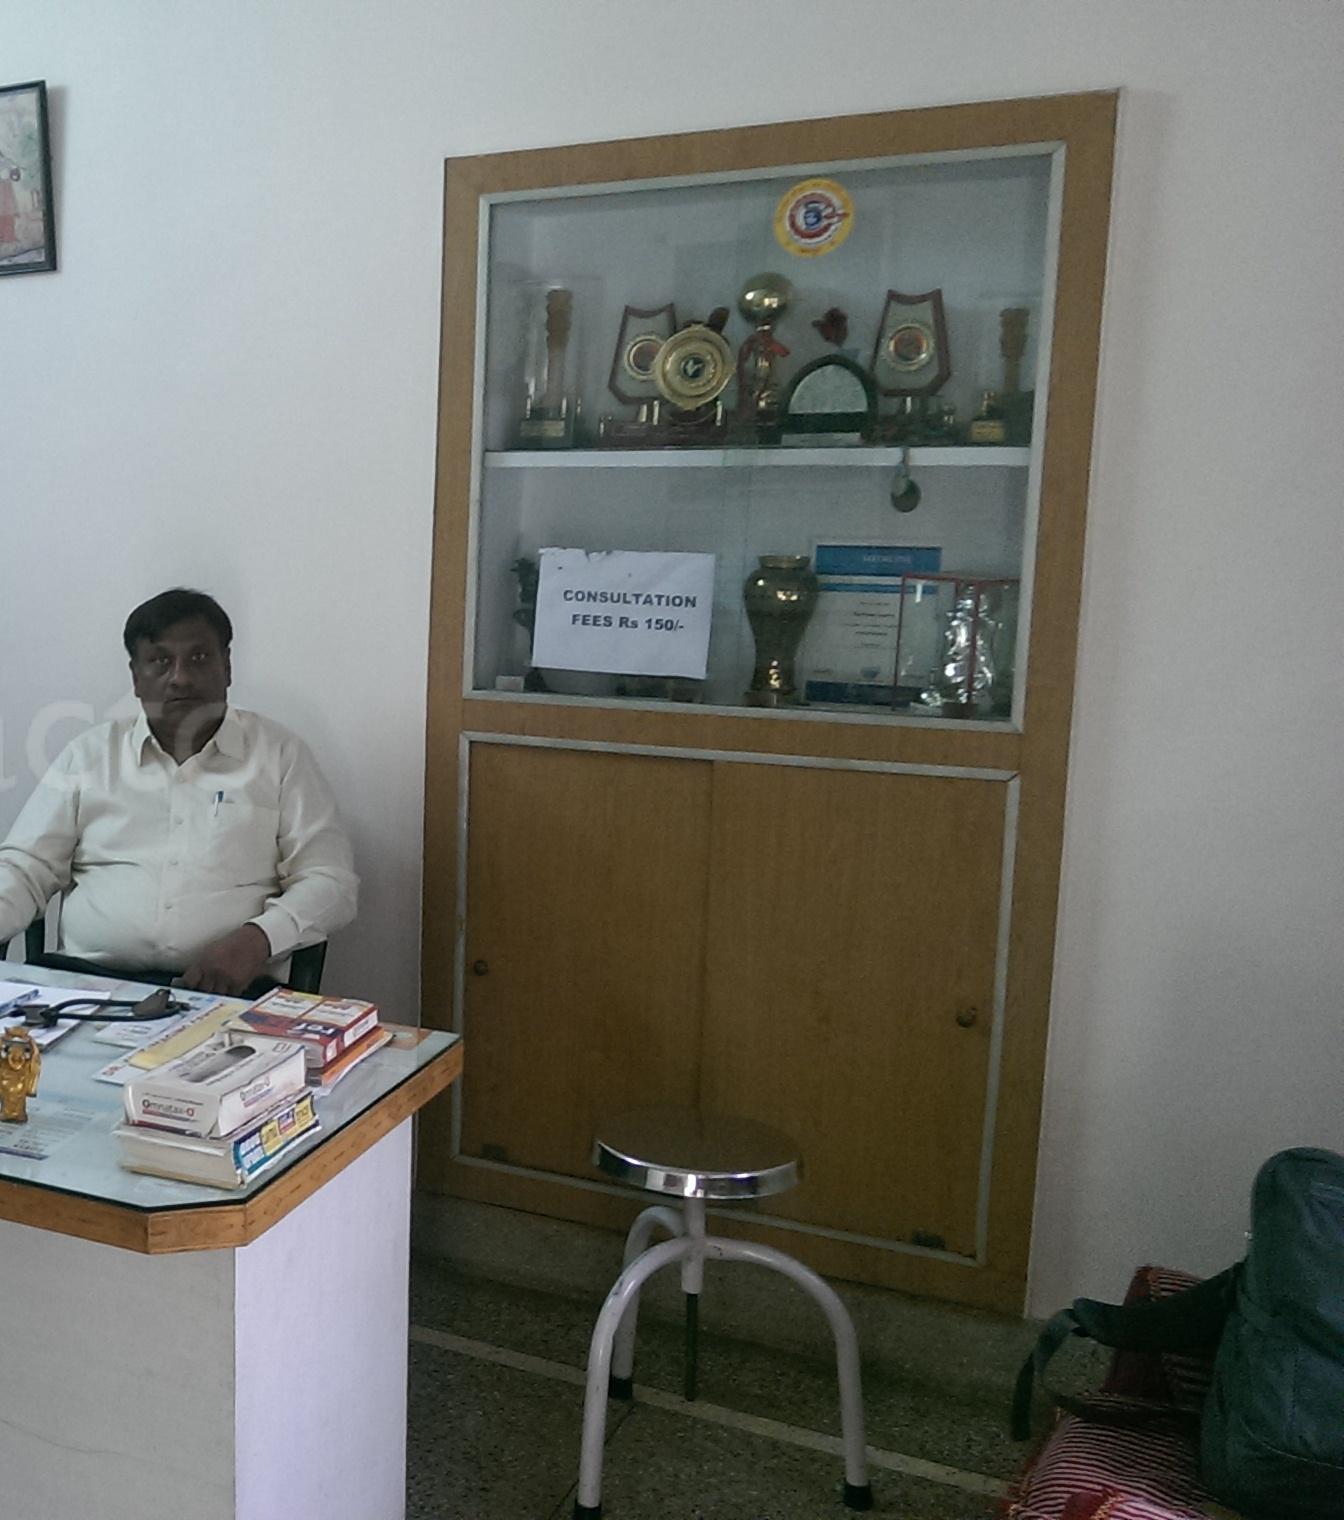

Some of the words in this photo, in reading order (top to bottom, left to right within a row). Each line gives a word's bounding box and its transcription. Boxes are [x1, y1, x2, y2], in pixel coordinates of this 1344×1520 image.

[563, 589, 697, 608] CONSULTATION
[571, 613, 613, 628] FEES
[619, 616, 639, 629] Rs
[645, 618, 684, 632] 150/-
